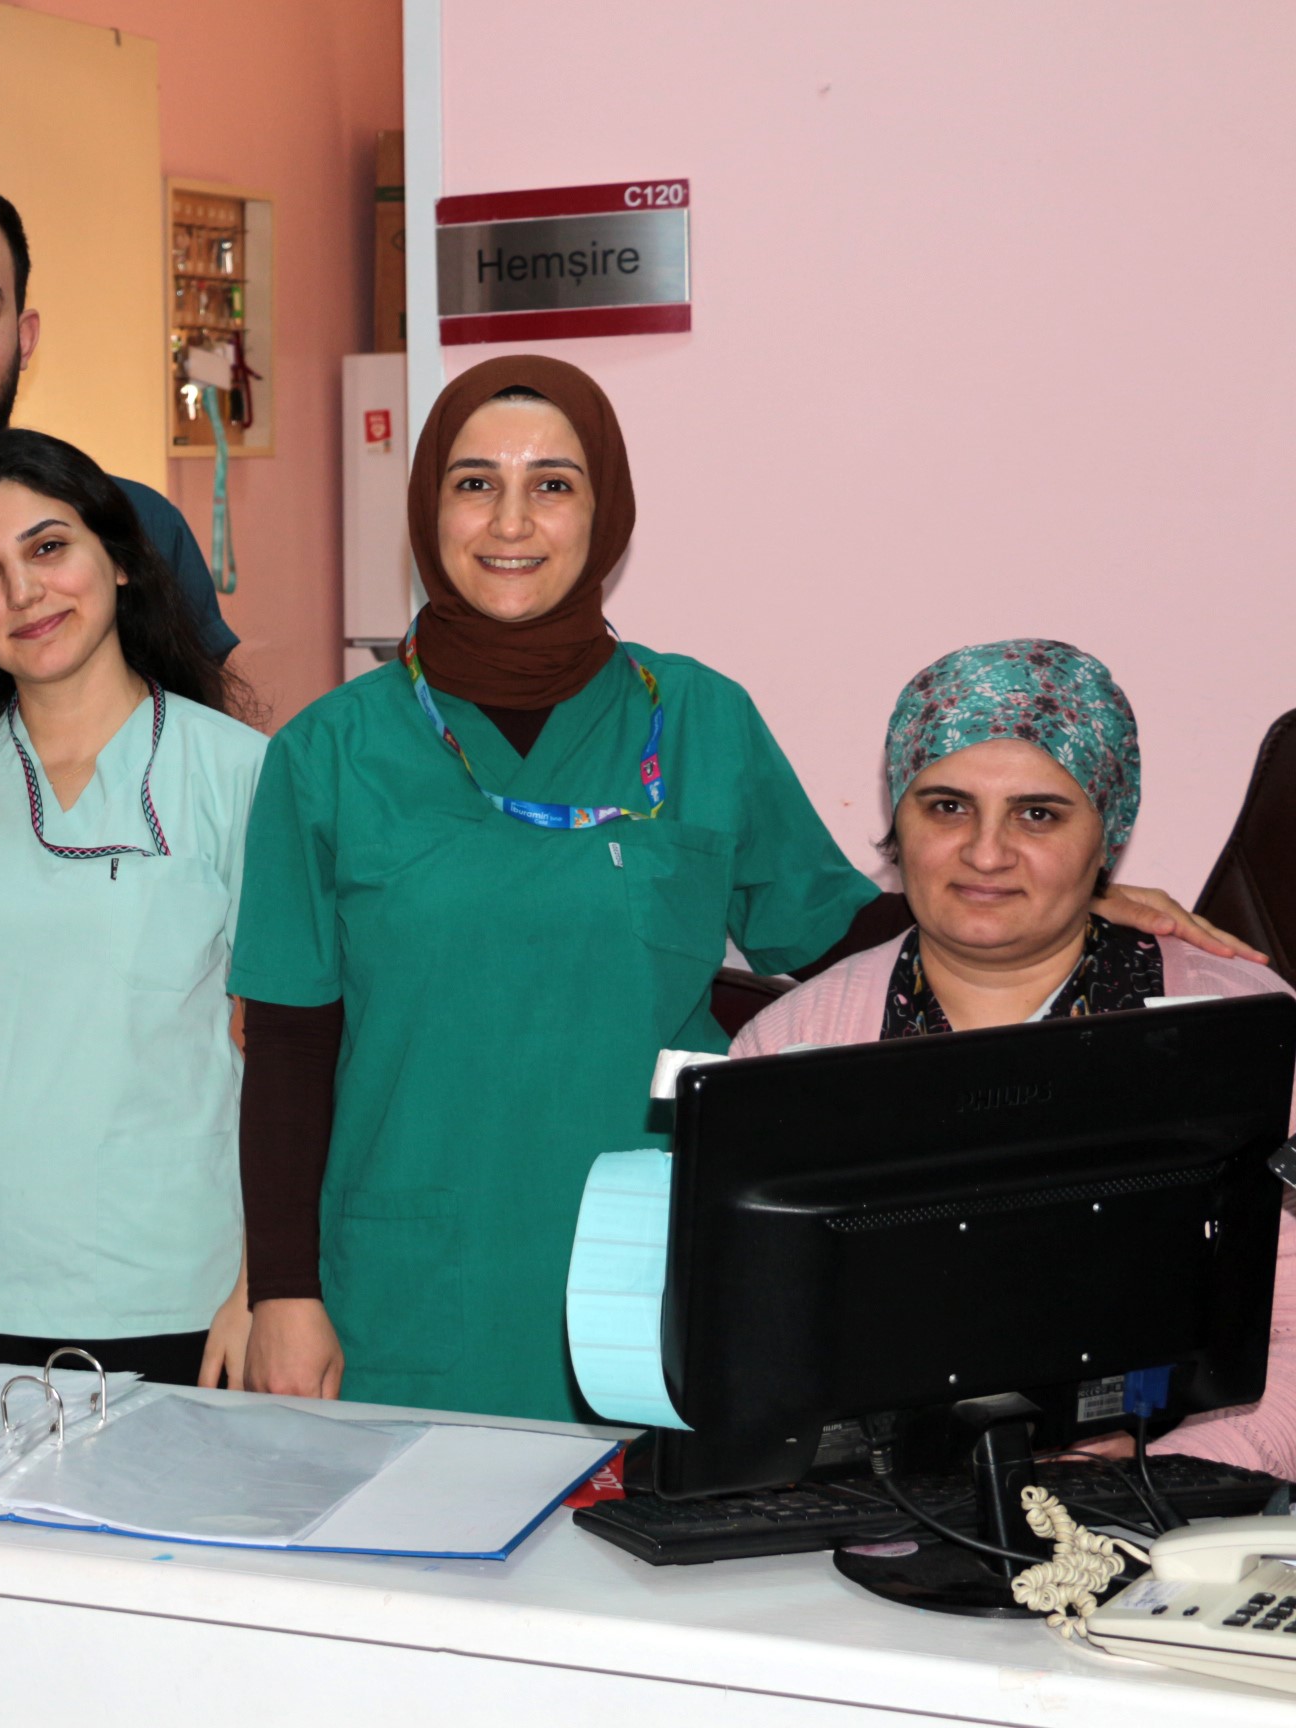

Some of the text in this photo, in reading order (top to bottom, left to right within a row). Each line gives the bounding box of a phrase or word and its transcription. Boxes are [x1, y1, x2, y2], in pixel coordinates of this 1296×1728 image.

[624, 184, 683, 207] C120
[477, 241, 640, 286] Hemşire
[954, 1081, 1052, 1113] PHILIPS
